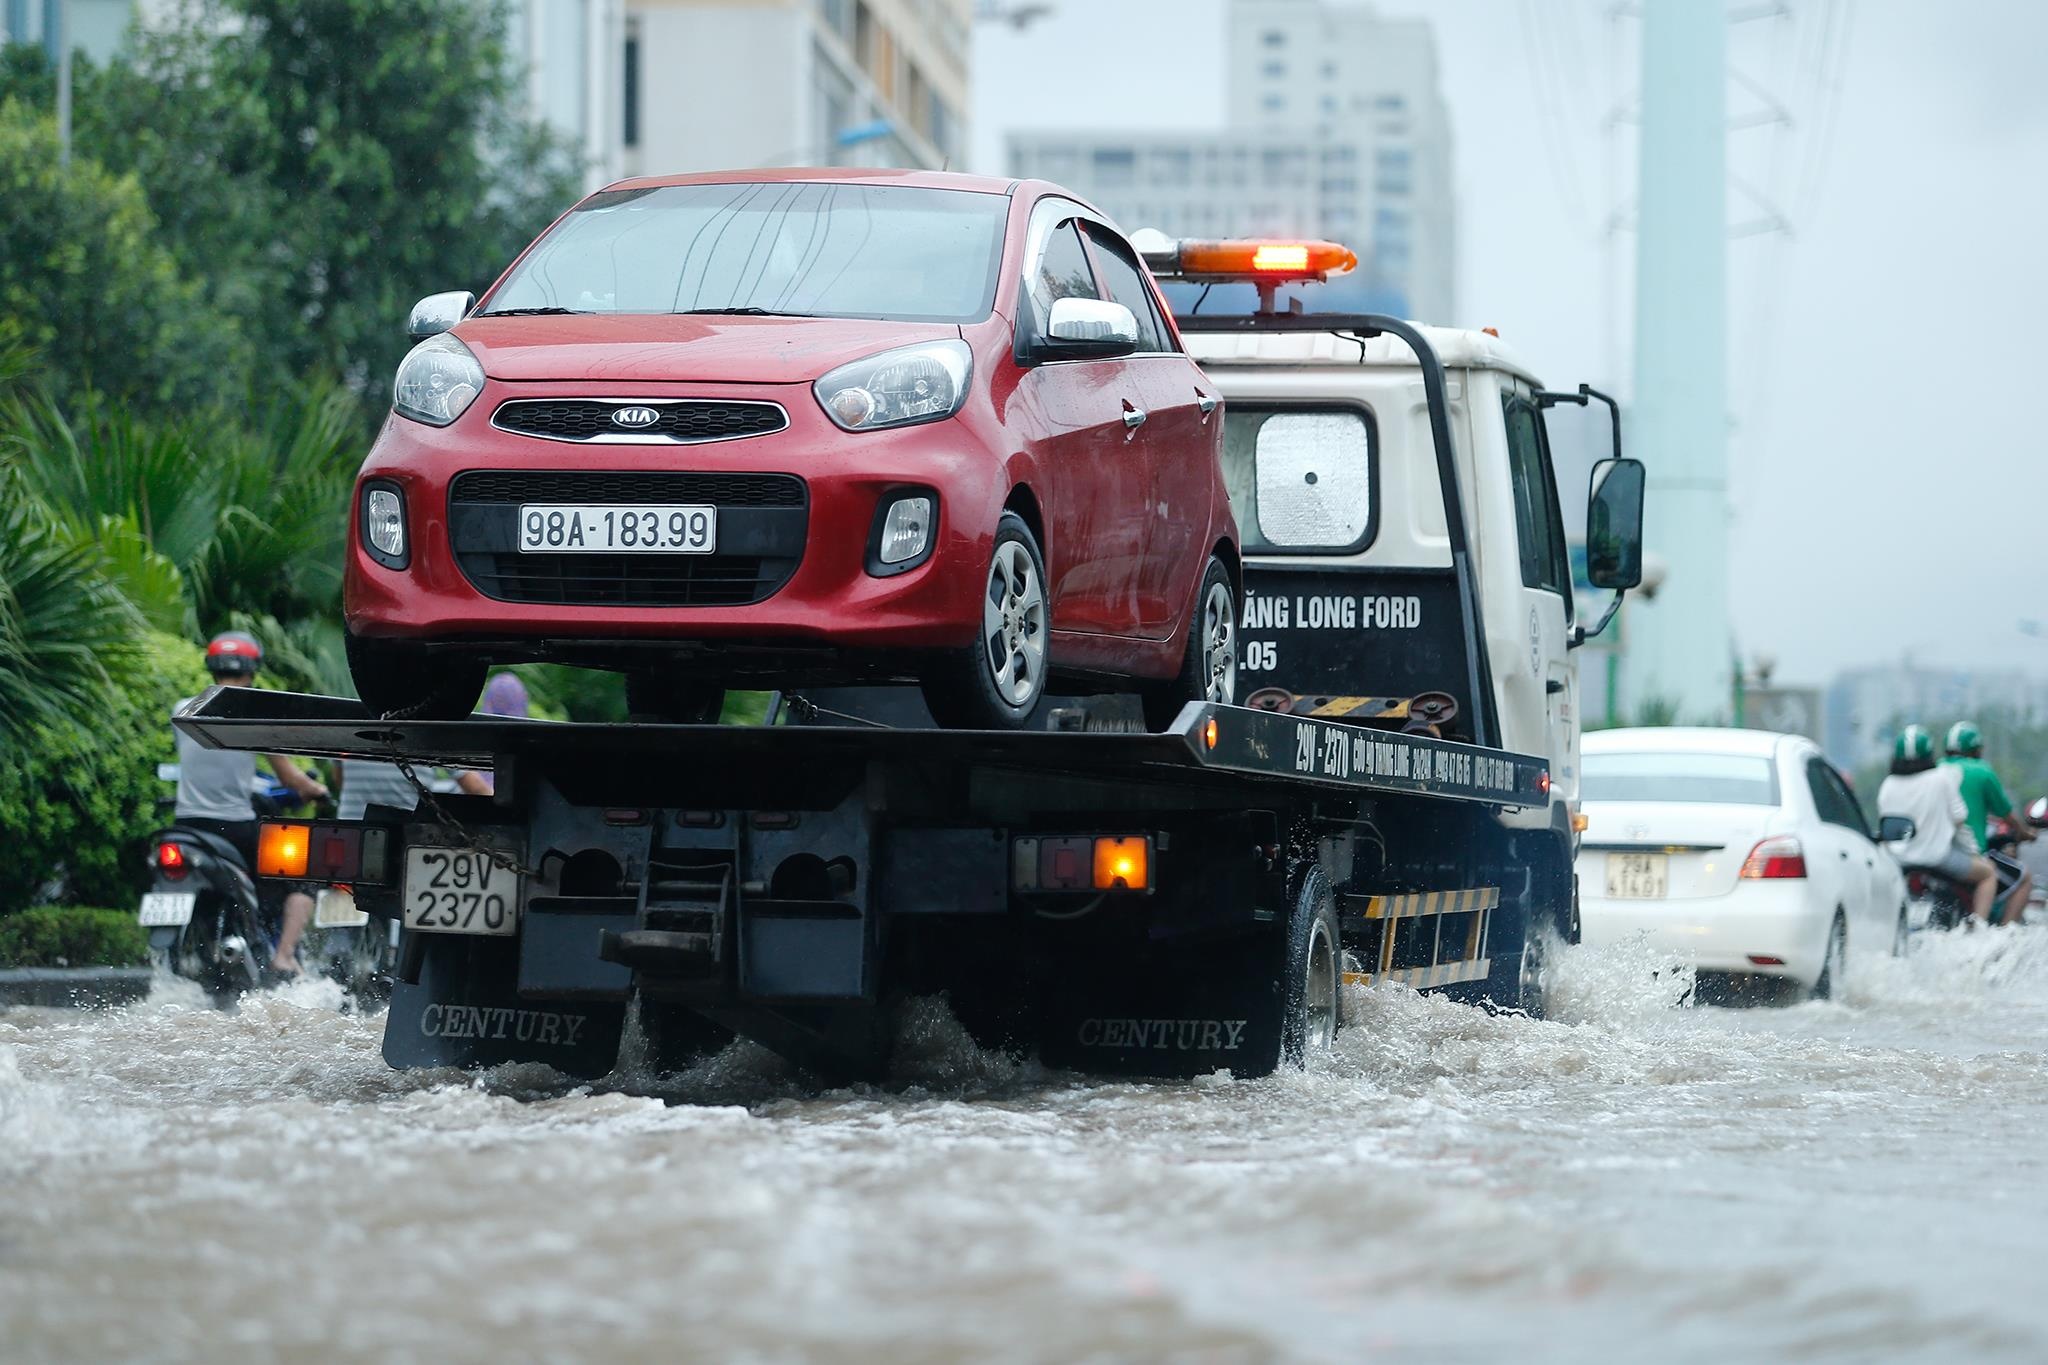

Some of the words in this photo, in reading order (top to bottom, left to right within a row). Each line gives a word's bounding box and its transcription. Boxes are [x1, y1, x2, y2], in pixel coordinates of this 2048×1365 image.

[618, 409, 651, 422] KIA
[526, 511, 708, 547] 98A-183.99
[1239, 589, 1289, 629] ĂNG
[1296, 596, 1356, 629] LONG
[1363, 596, 1421, 629] FORD
[1237, 641, 1277, 671] .05
[1295, 722, 1317, 773] 29V
[1324, 726, 1350, 779] 2370
[430, 853, 494, 890] 29V
[416, 891, 505, 929] 2370
[420, 1003, 587, 1046] CENTURY
[1078, 1018, 1248, 1050] CENTURY
